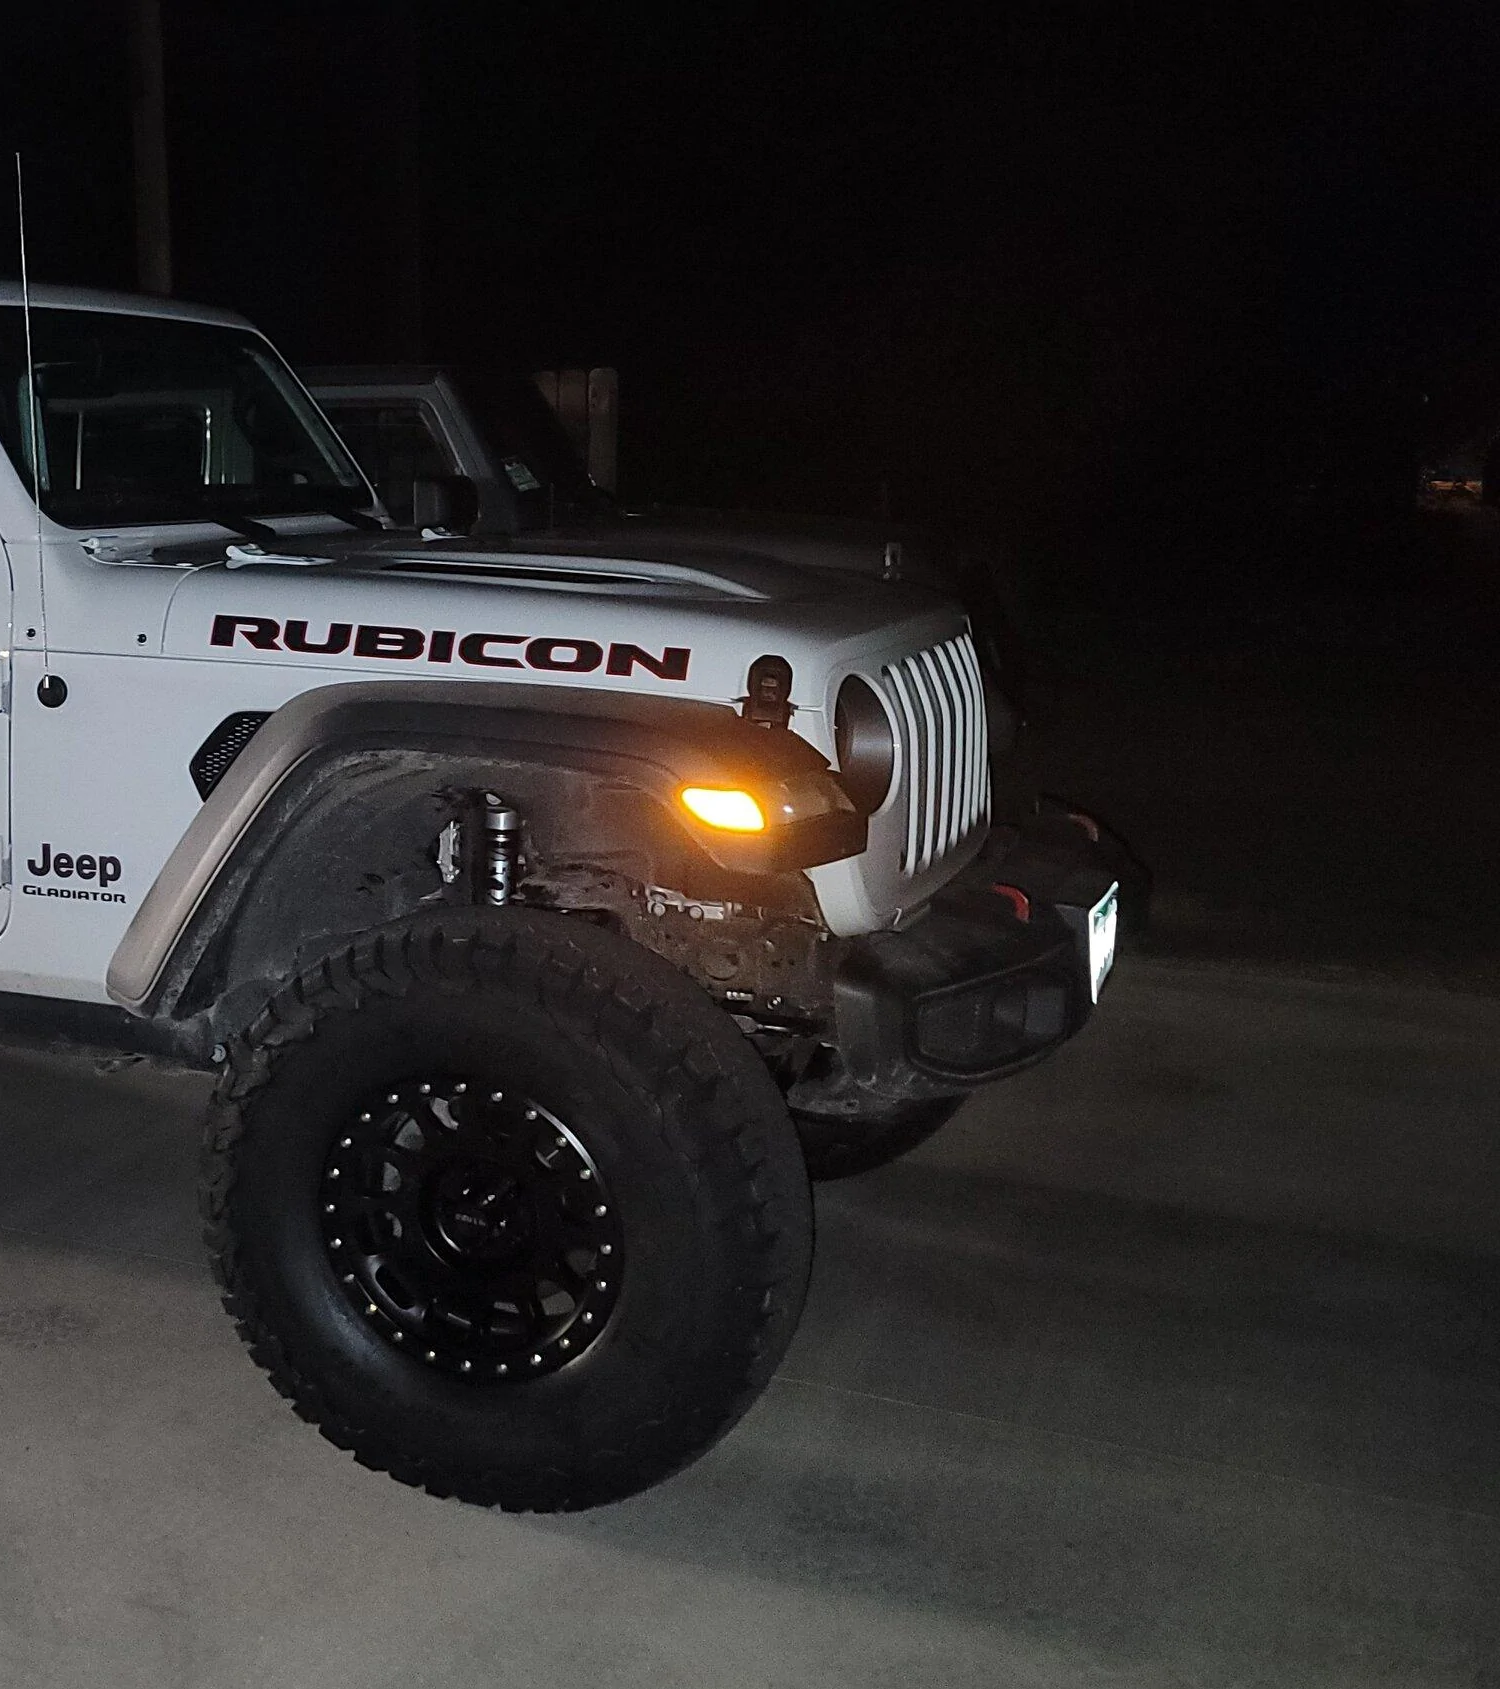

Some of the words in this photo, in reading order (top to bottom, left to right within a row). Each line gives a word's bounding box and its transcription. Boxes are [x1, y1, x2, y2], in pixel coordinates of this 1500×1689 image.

[209, 613, 691, 681] RUBICON
[27, 843, 122, 888] Jeep
[22, 884, 127, 904] GLADIATOR
